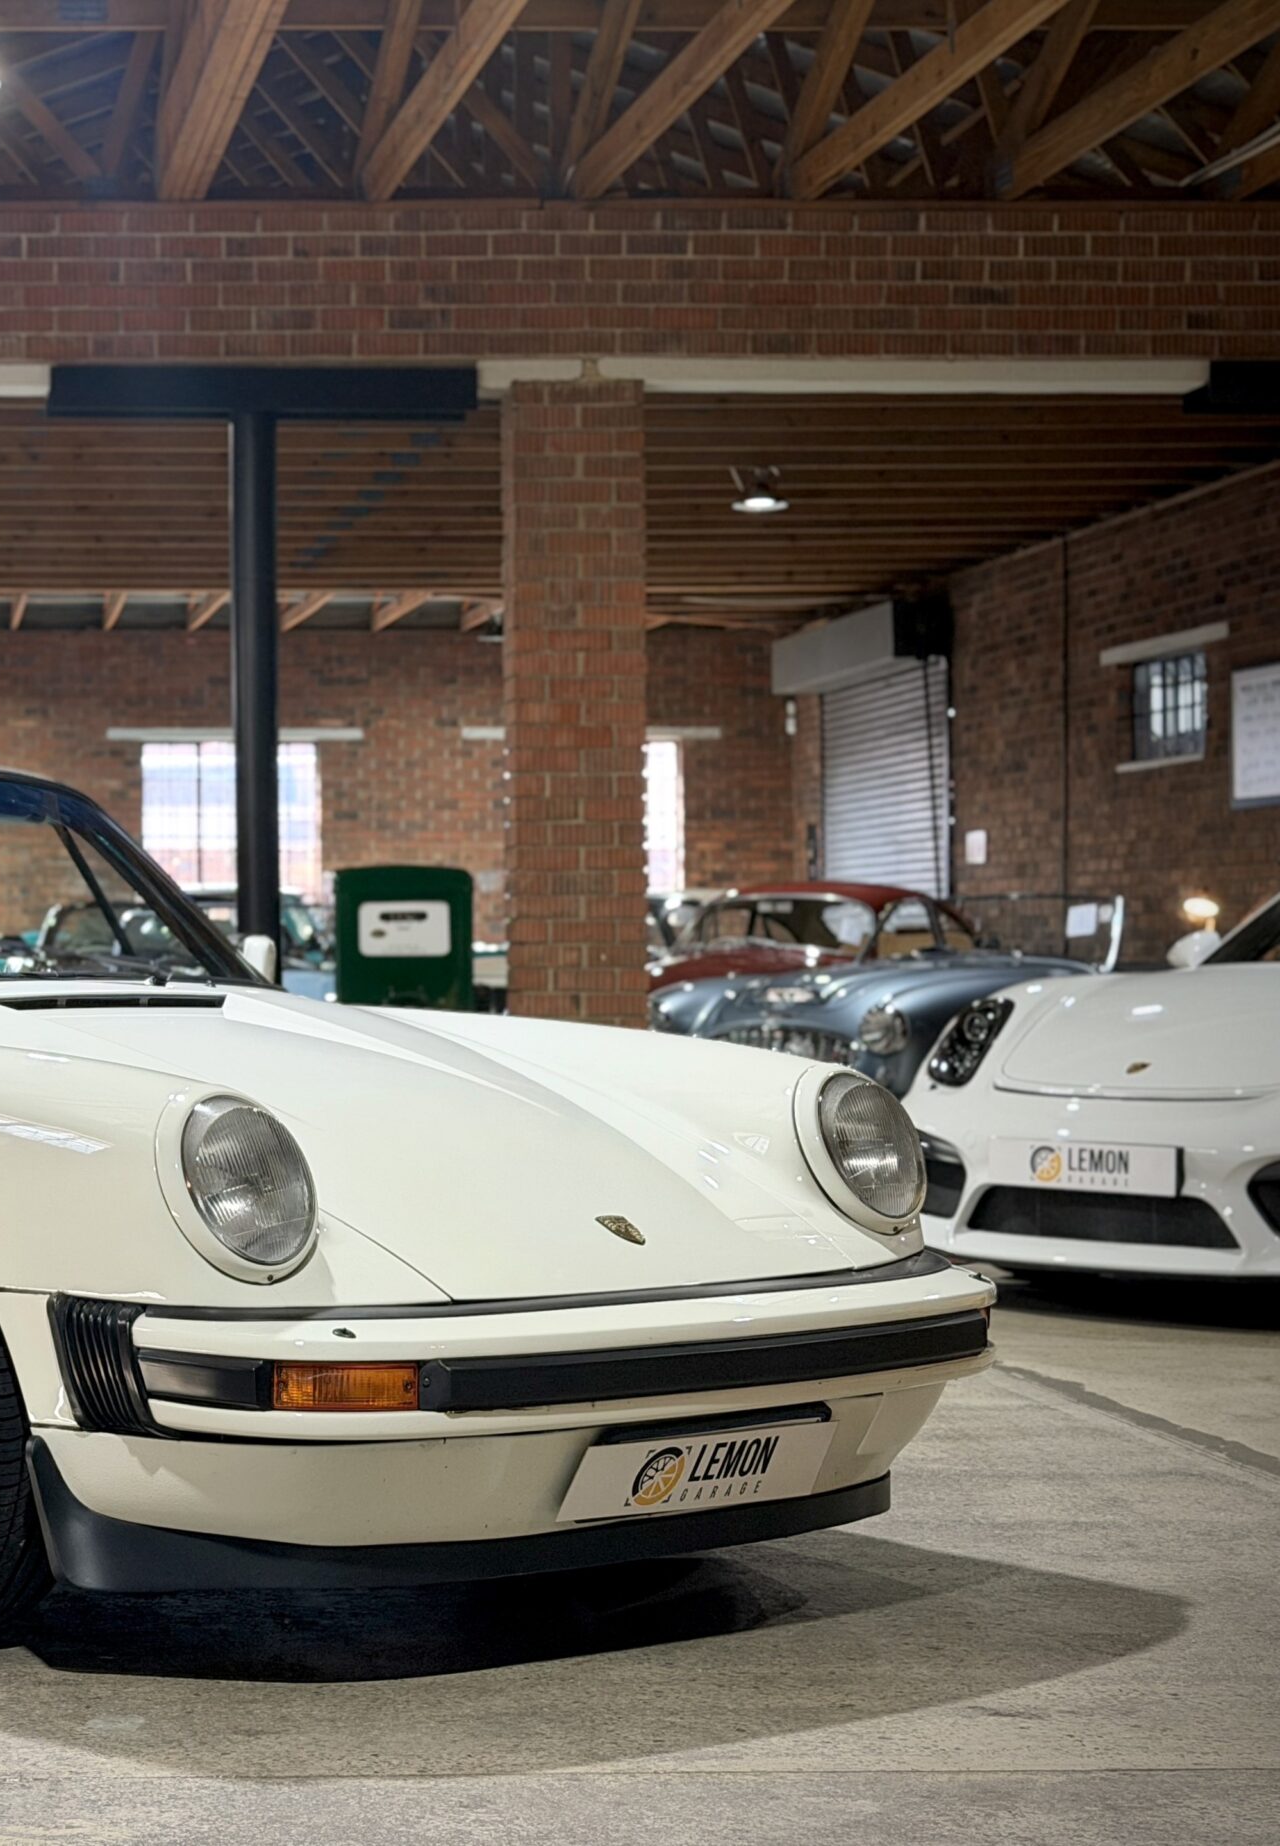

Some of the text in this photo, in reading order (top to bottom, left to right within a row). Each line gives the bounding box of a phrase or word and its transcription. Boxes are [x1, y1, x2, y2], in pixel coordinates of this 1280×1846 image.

[1068, 1147, 1130, 1174] LEMON
[687, 1435, 780, 1482] LEMON
[680, 1480, 762, 1502] GARAGE
